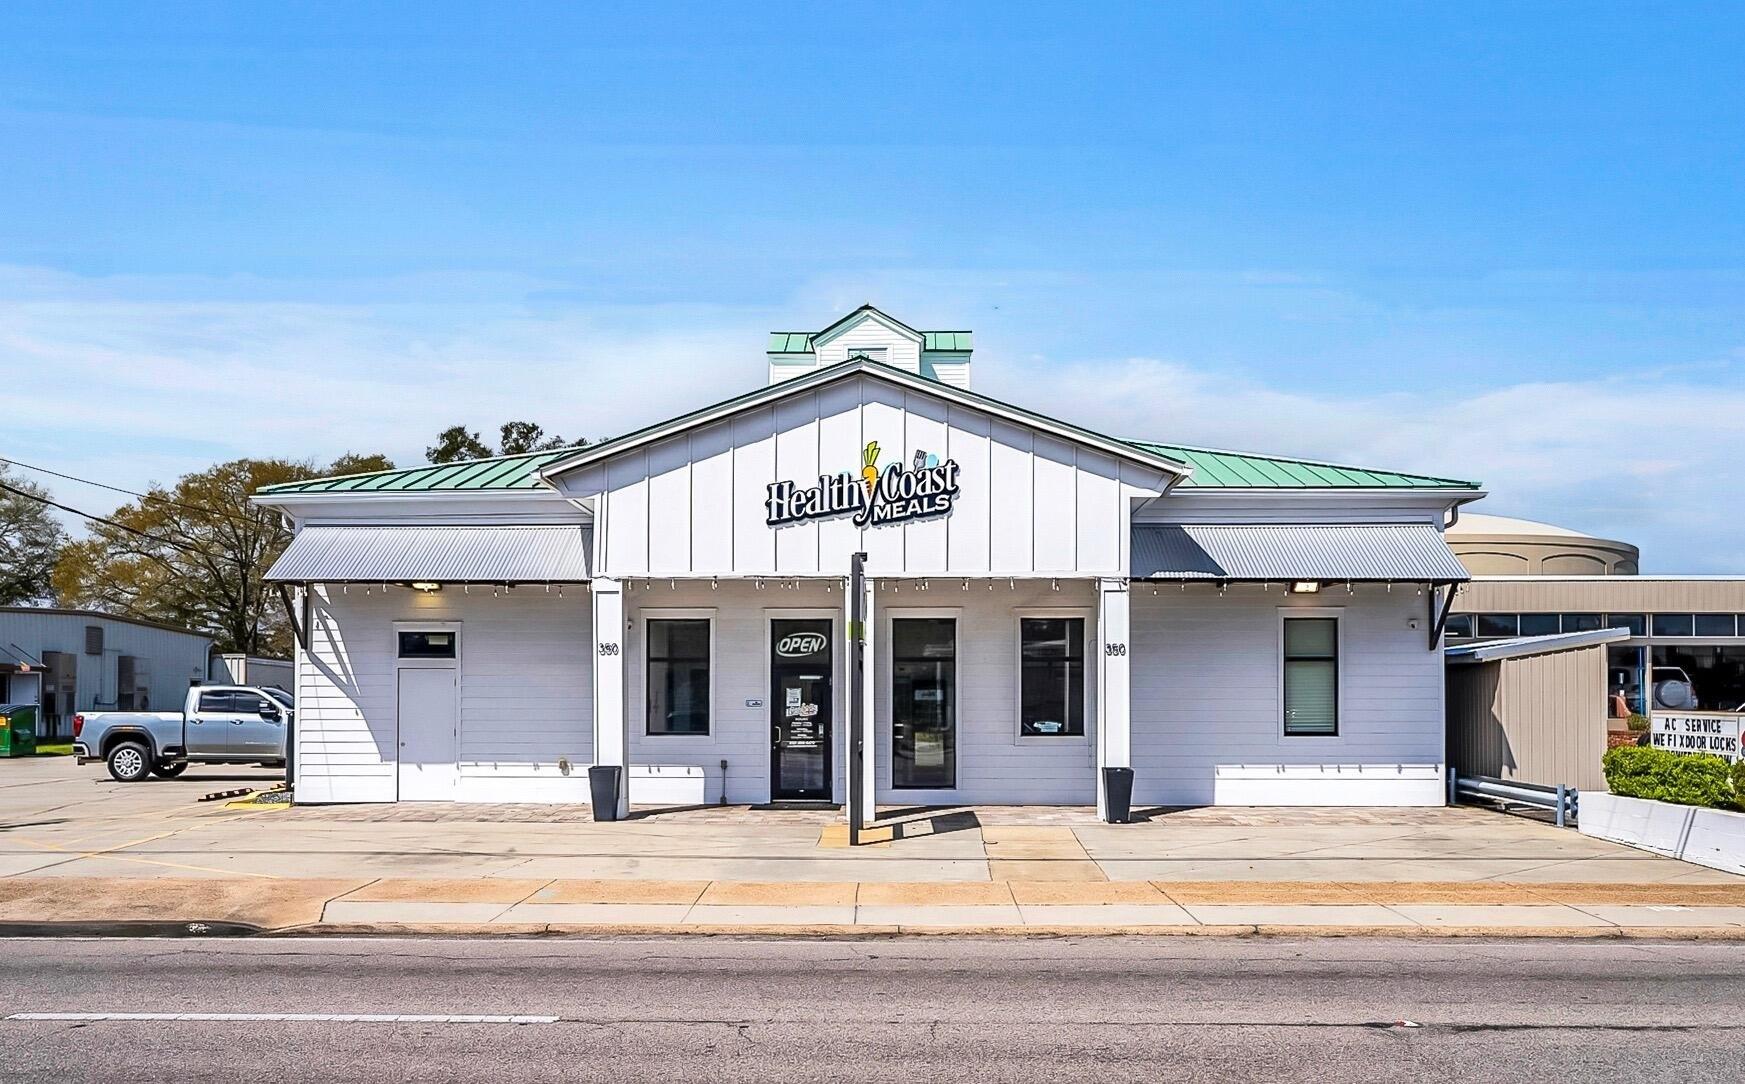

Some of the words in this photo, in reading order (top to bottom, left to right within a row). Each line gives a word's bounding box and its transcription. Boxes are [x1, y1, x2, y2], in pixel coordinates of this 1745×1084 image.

[766, 472, 880, 526] Healthy
[881, 459, 958, 502] Coast
[873, 494, 950, 522] MEALS
[779, 637, 821, 652] OPEN
[1665, 718, 1676, 731] AC
[1685, 718, 1721, 733] SERVICE
[1653, 733, 1665, 746] WE
[1710, 736, 1736, 752] LOCKS
